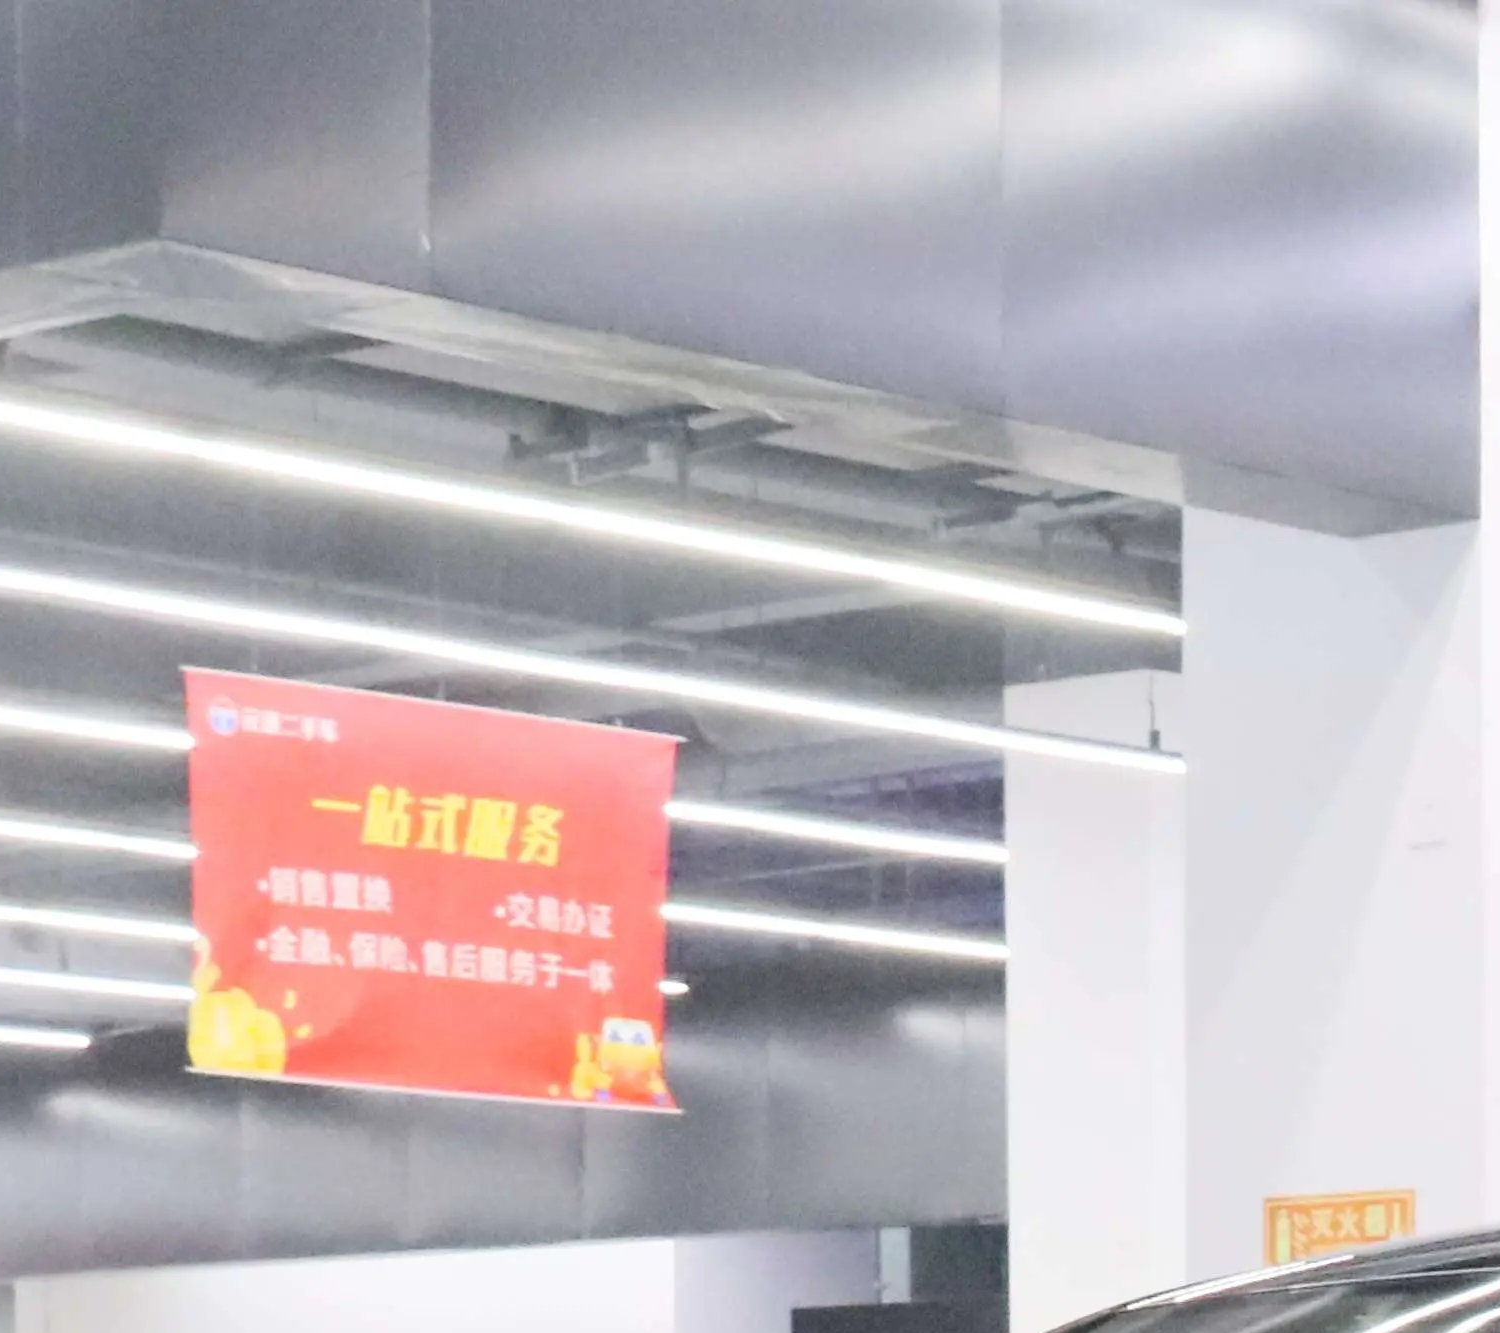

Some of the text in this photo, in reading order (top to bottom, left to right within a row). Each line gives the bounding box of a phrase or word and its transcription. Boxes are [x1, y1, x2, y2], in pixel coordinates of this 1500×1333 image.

[311, 783, 564, 867] 一站式服务
[506, 892, 614, 940] 交易办证
